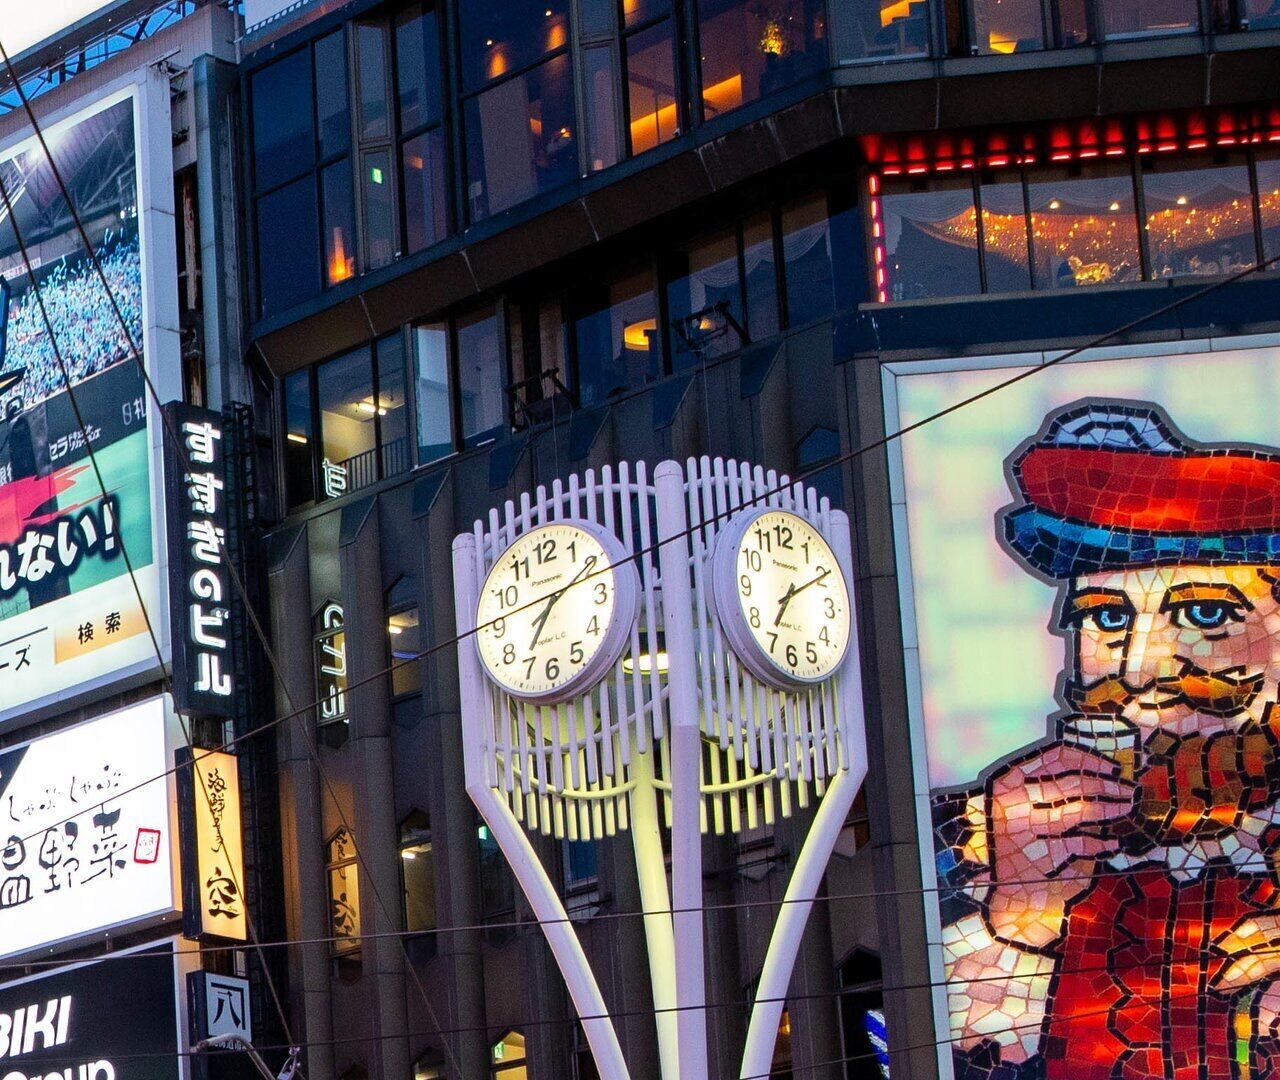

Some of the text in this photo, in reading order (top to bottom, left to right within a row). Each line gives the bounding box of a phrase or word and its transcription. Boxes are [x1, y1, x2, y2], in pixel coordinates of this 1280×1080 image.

[754, 528, 771, 553] 11
[773, 525, 793, 550] 12
[182, 420, 232, 698] すすきのビル
[533, 539, 557, 565] 12
[566, 541, 577, 563] 1
[742, 550, 762, 572] 10
[801, 542, 810, 564] 1
[510, 557, 531, 583] 11
[772, 559, 798, 573] Panasonic
[531, 573, 563, 588] Panasonic
[740, 575, 751, 597] 9
[494, 585, 519, 610] 10
[593, 583, 607, 605] 3
[750, 607, 761, 628] 8
[824, 597, 835, 619] 3
[77, 611, 123, 645] 検索
[493, 617, 506, 638] 9
[585, 615, 600, 637] 4
[818, 626, 829, 647] 4
[569, 641, 584, 665] 5
[766, 631, 779, 654] 7
[806, 641, 818, 664] 5
[503, 643, 516, 665] 8
[786, 644, 798, 667] 6
[522, 656, 537, 680] 7
[545, 658, 560, 680] 6
